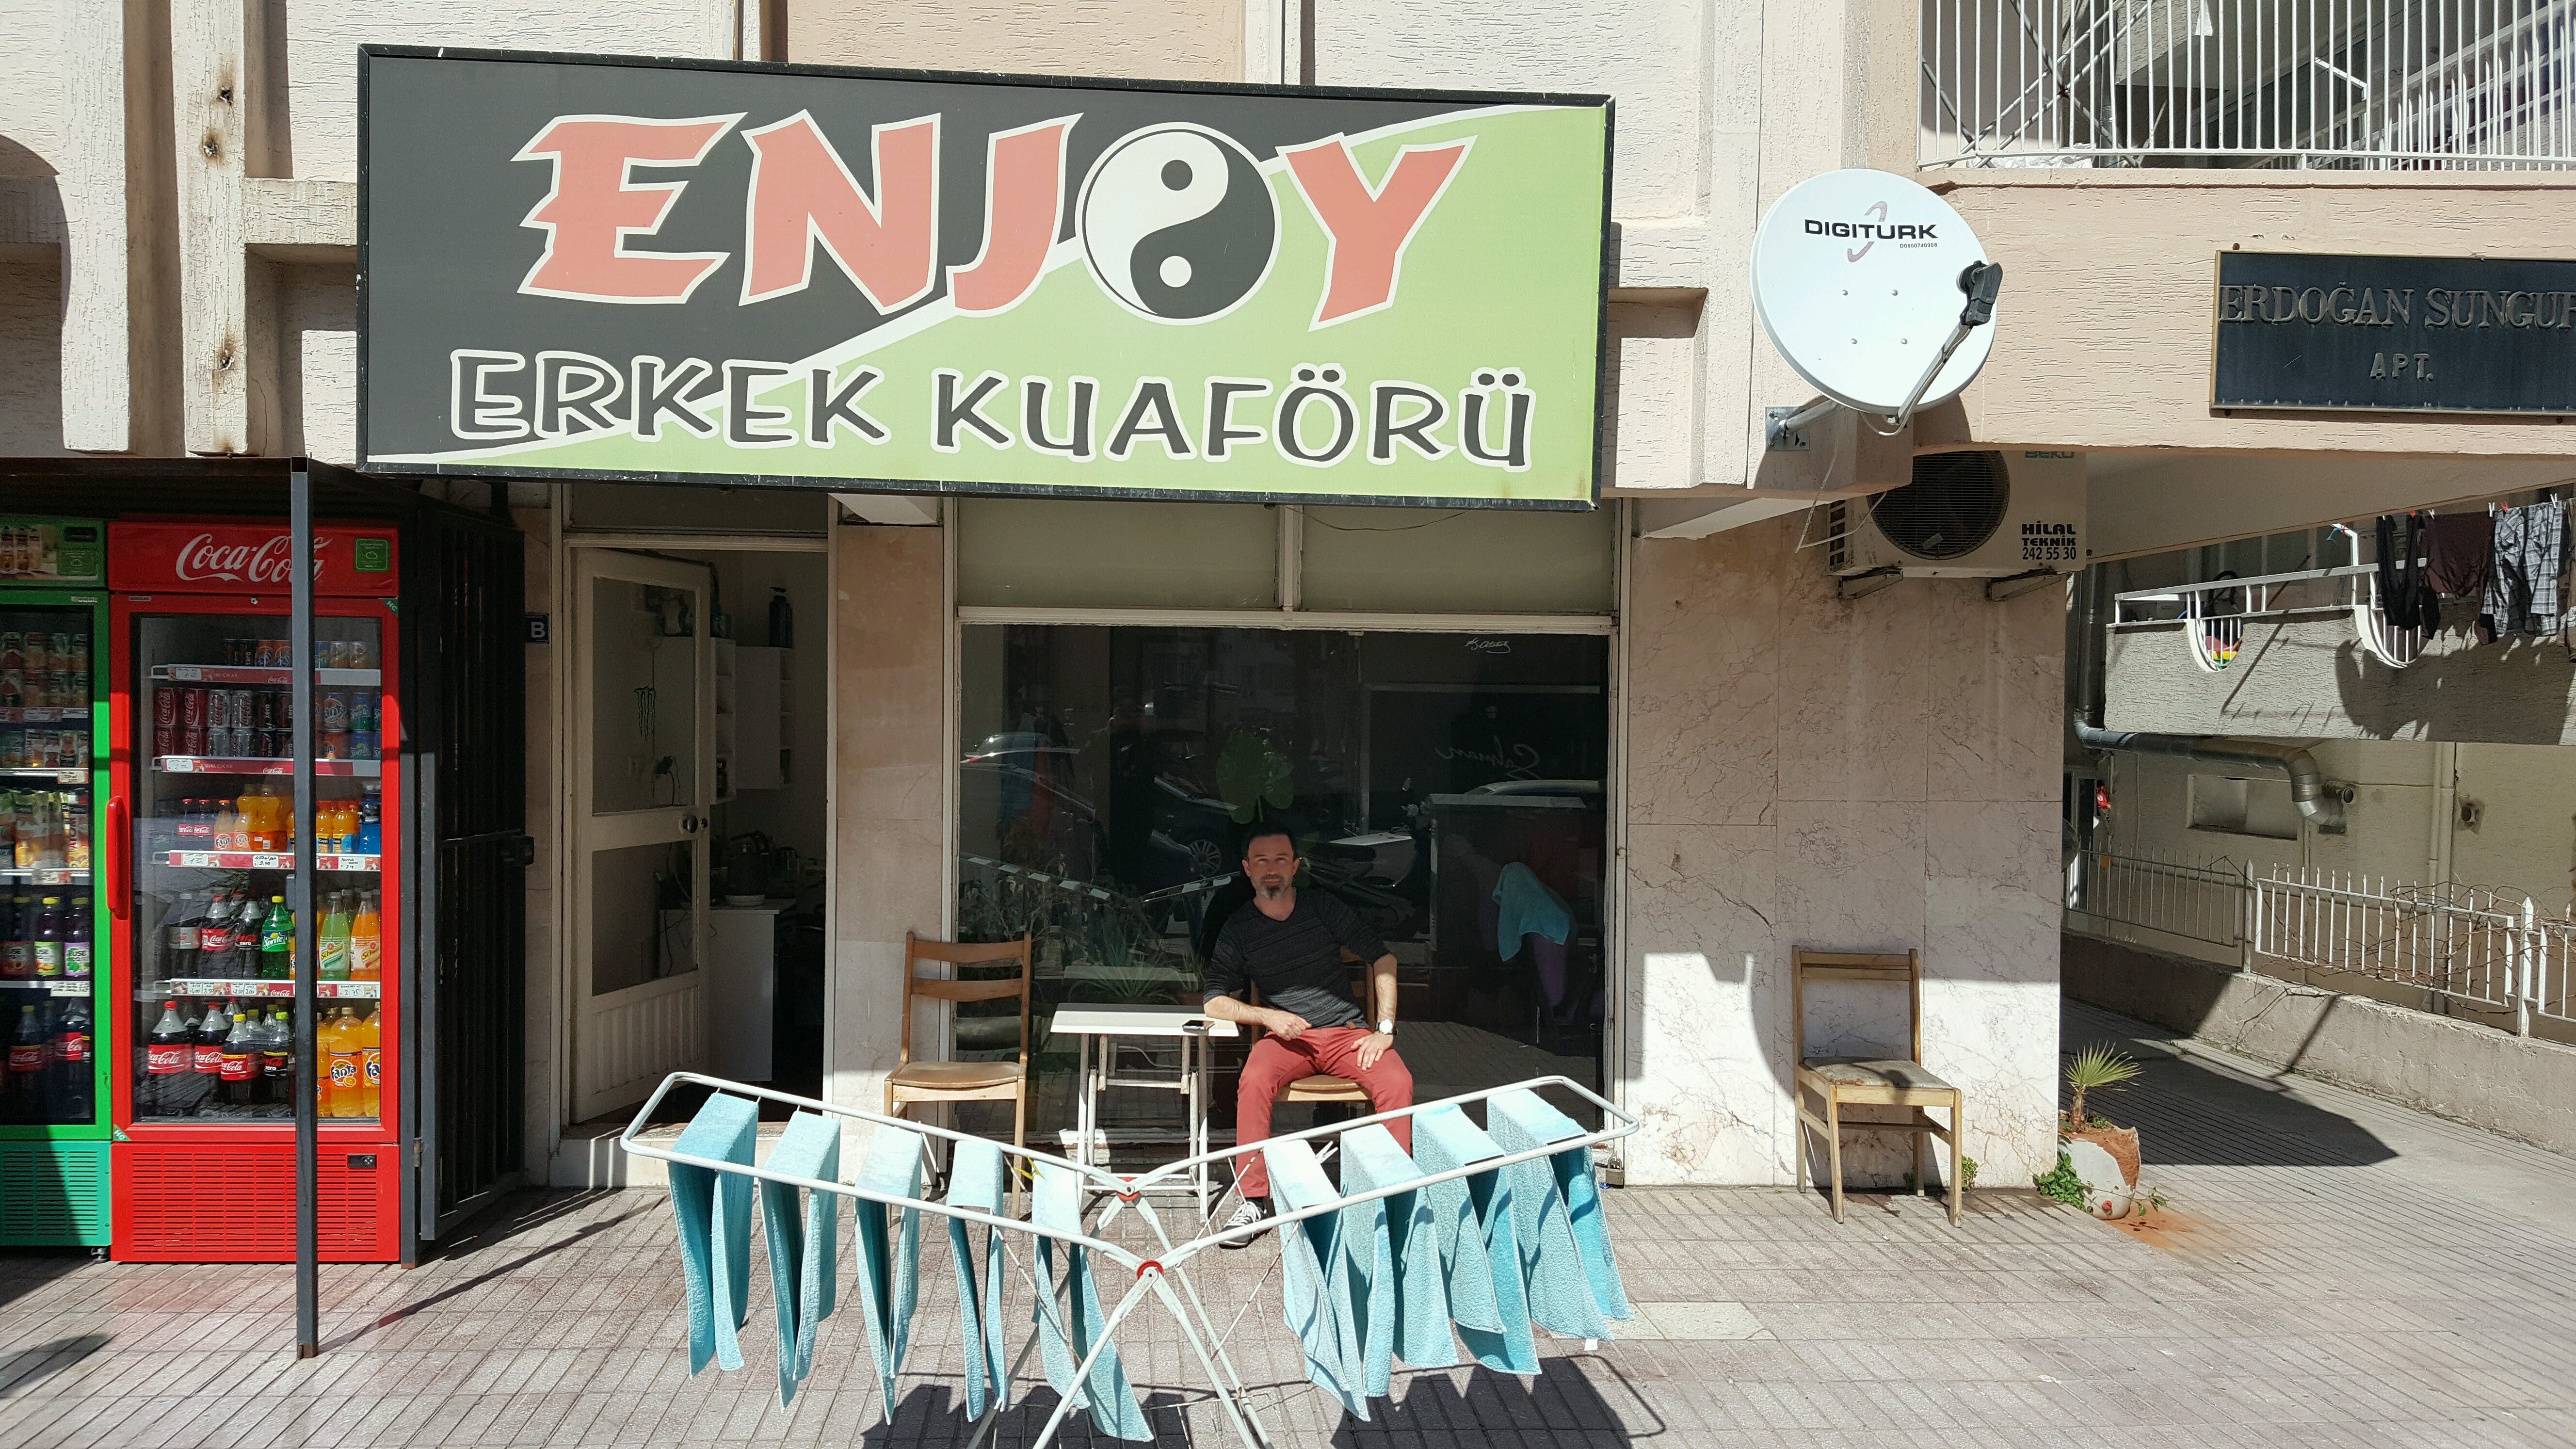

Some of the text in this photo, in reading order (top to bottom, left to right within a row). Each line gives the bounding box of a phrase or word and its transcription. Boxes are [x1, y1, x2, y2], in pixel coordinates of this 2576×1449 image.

[511, 108, 1478, 332] ENJOY
[1804, 219, 1939, 239] DIGITURK
[2219, 281, 2415, 327] ERDOĞAN
[2369, 352, 2433, 382] APT.
[450, 349, 1537, 473] ERKEK KUAFÖRÜ
[2021, 520, 2077, 535] HİLAL
[2021, 535, 2077, 547] TEKNİK
[176, 533, 334, 583] Coca-Coa
[2022, 547, 2077, 560] 242 55 30
[159, 691, 170, 724] Coca-Cola
[184, 692, 194, 725] Coca-Cola
[263, 936, 284, 947] Sprite
[331, 1064, 357, 1081] Fanta
